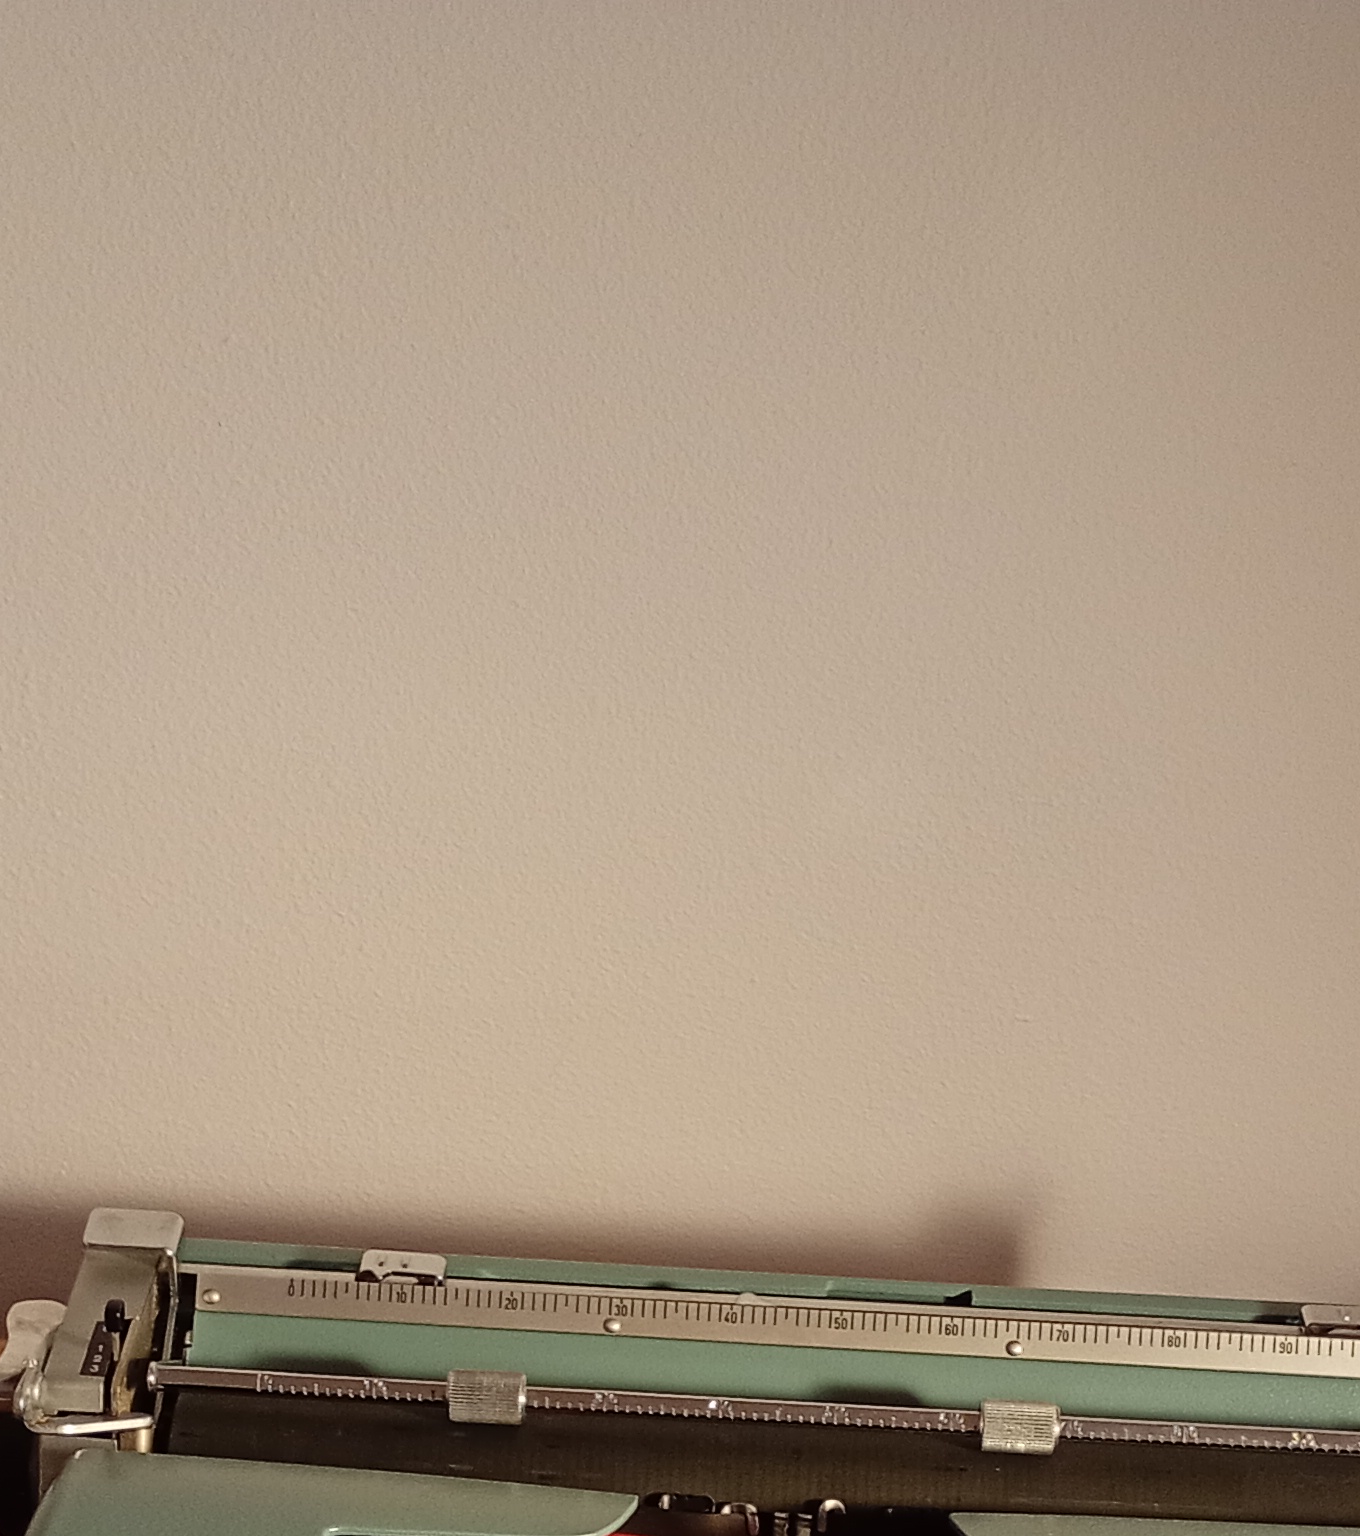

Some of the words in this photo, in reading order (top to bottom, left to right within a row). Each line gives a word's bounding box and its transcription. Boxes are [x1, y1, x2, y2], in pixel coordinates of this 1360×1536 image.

[504, 1299, 518, 1310] 20
[614, 1304, 628, 1317] 30
[724, 1312, 738, 1325] 40
[834, 1317, 848, 1330] 50
[944, 1323, 959, 1336] 60
[1055, 1329, 1069, 1342] 70
[1167, 1334, 1181, 1348] 80
[1279, 1341, 1292, 1354] 90
